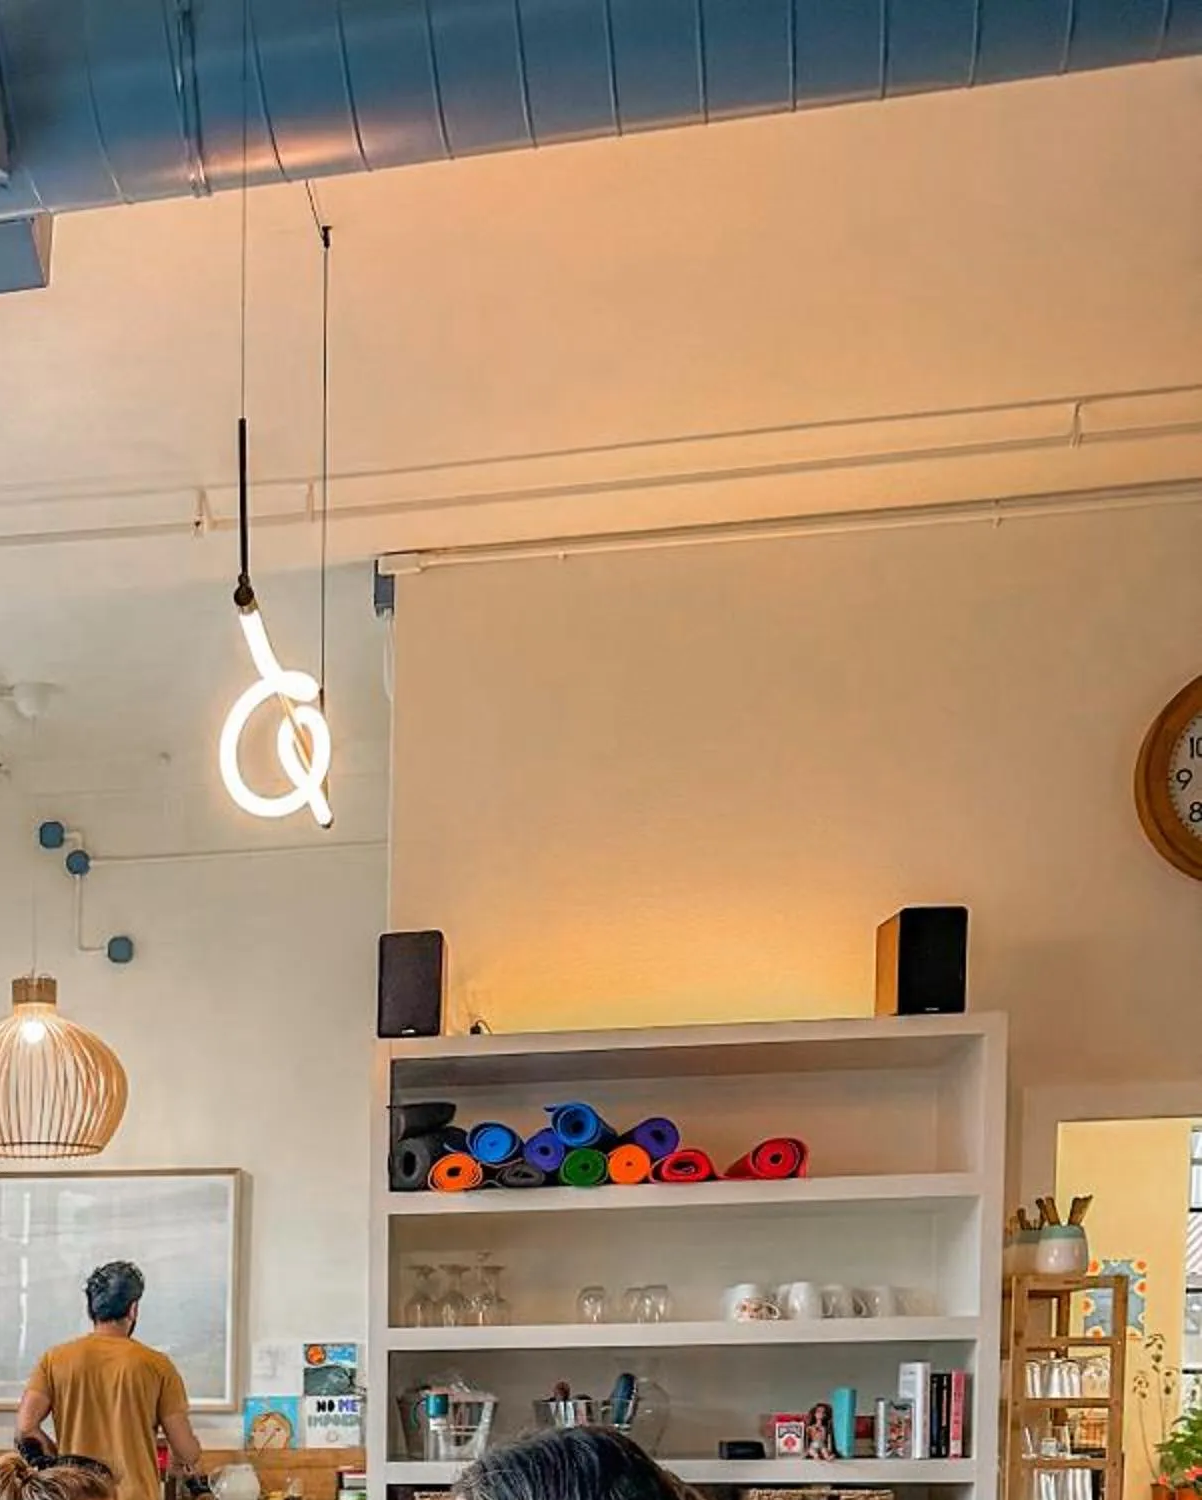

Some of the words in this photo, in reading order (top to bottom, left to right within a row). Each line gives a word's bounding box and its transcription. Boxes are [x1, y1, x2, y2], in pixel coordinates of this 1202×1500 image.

[1176, 767, 1193, 791] 9
[1189, 801, 1202, 822] 8
[316, 1399, 335, 1413] NO
